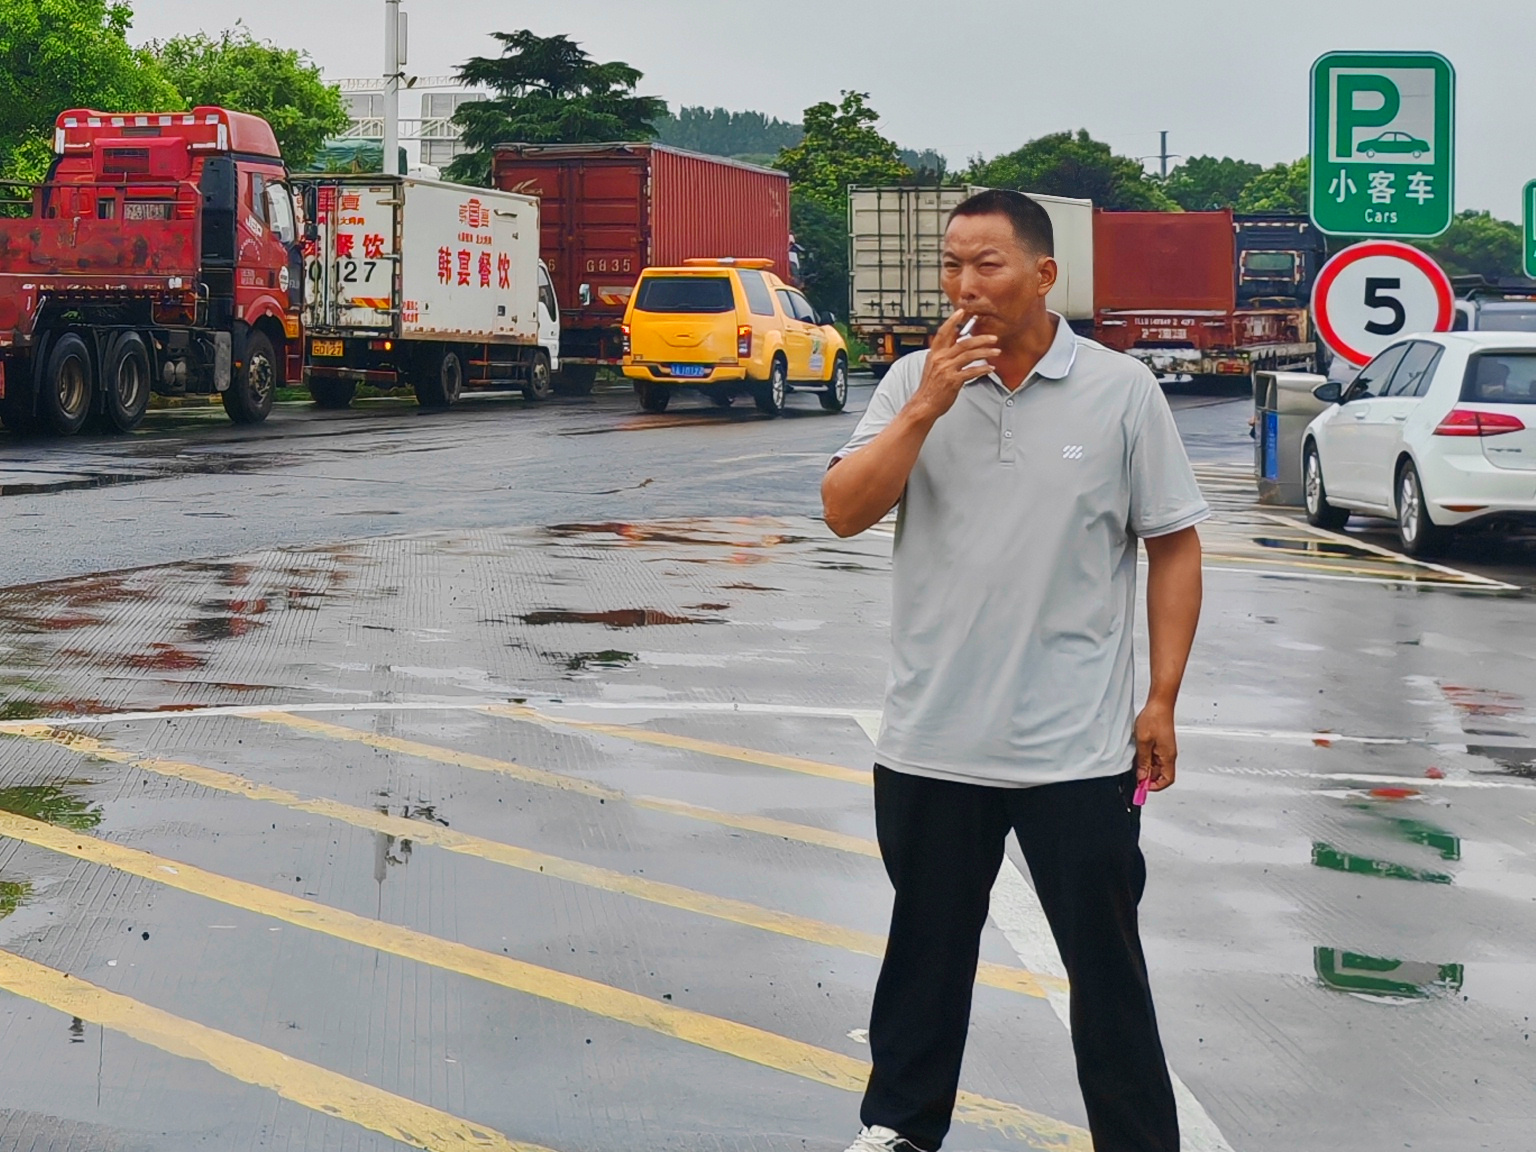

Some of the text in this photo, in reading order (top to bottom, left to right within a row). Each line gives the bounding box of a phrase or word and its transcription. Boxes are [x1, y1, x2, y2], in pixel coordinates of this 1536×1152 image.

[1335, 73, 1401, 158] P
[1328, 168, 1435, 205] 小客车
[1364, 208, 1398, 223] Cars
[437, 246, 510, 289] 韩宴餐饮
[1363, 276, 1406, 336] 5
